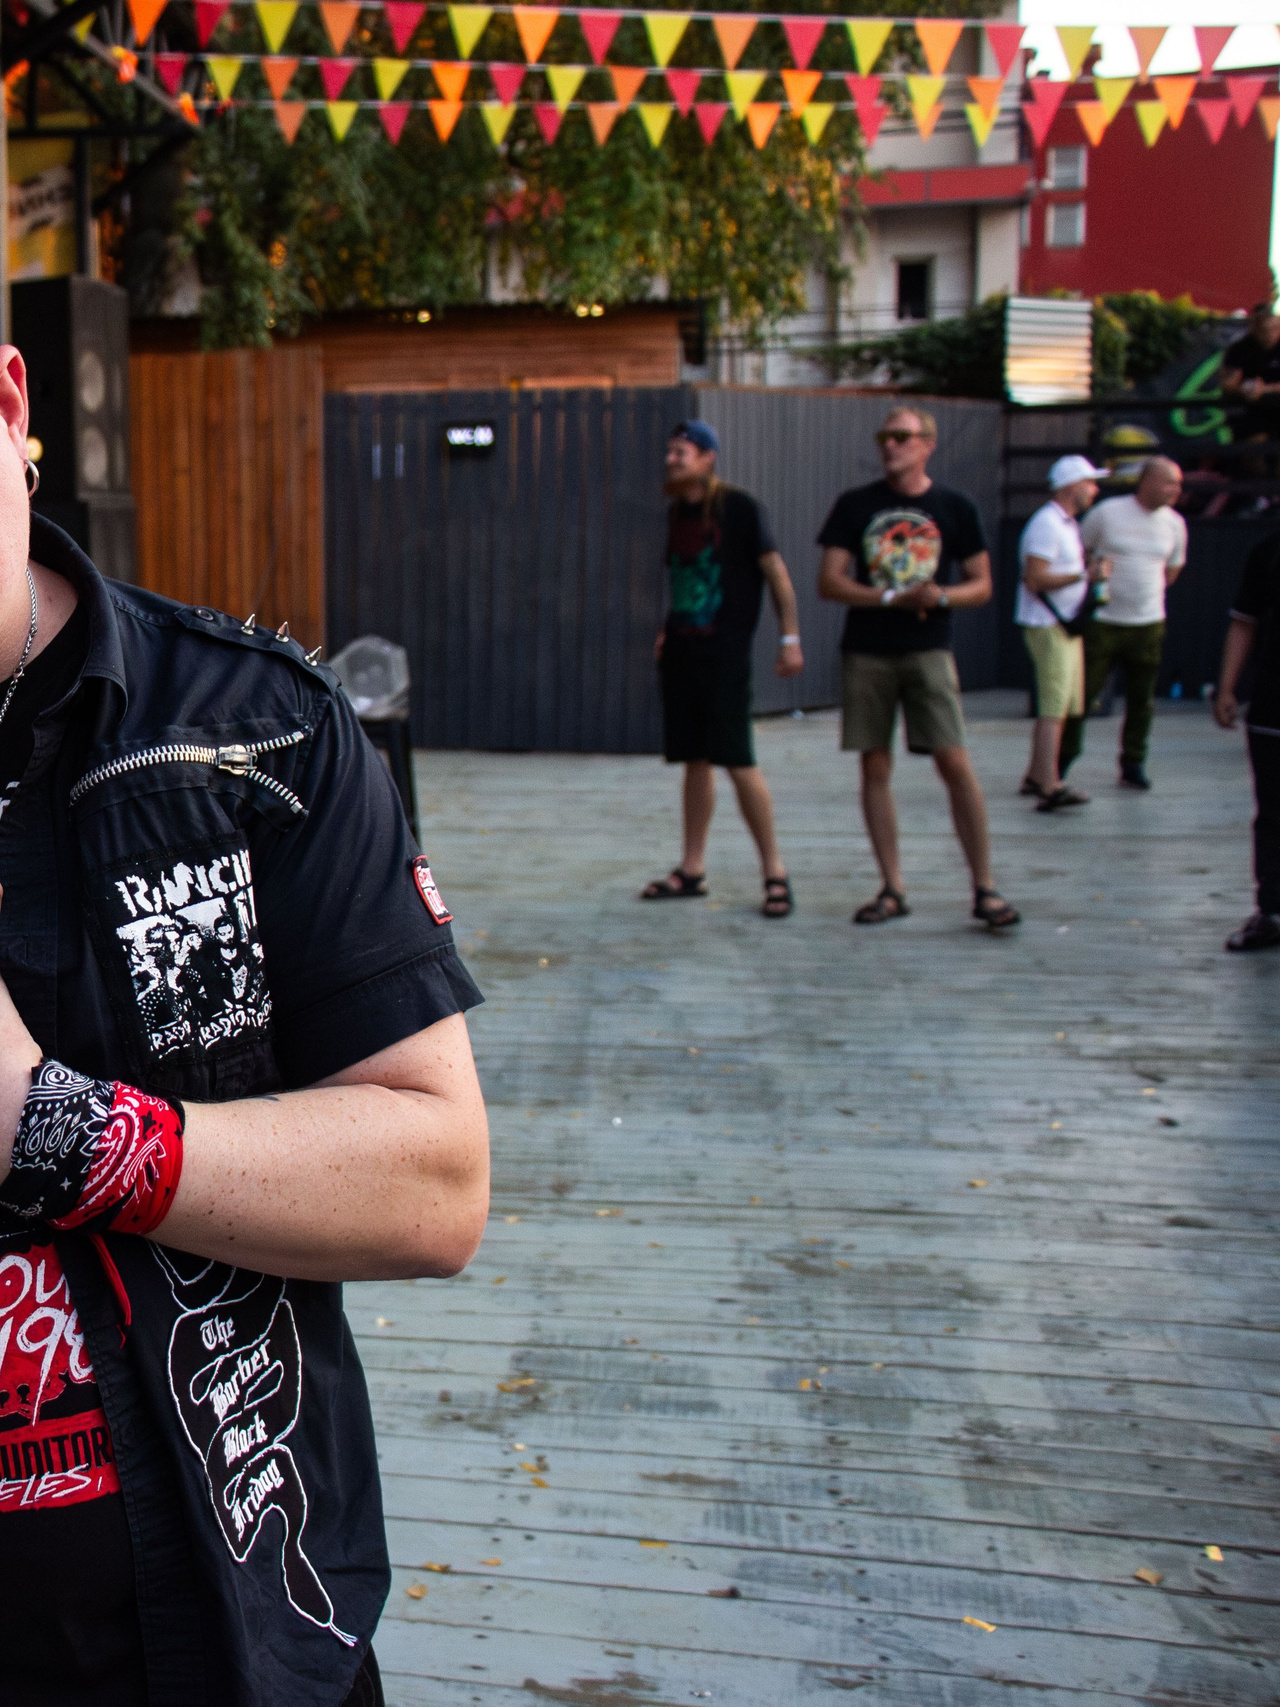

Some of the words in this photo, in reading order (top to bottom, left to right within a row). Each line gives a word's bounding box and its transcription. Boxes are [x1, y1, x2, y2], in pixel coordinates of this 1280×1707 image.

[200, 1315, 235, 1350] The
[209, 1338, 271, 1423] Barber
[223, 1411, 268, 1467] Black
[231, 1458, 284, 1542] Friday
